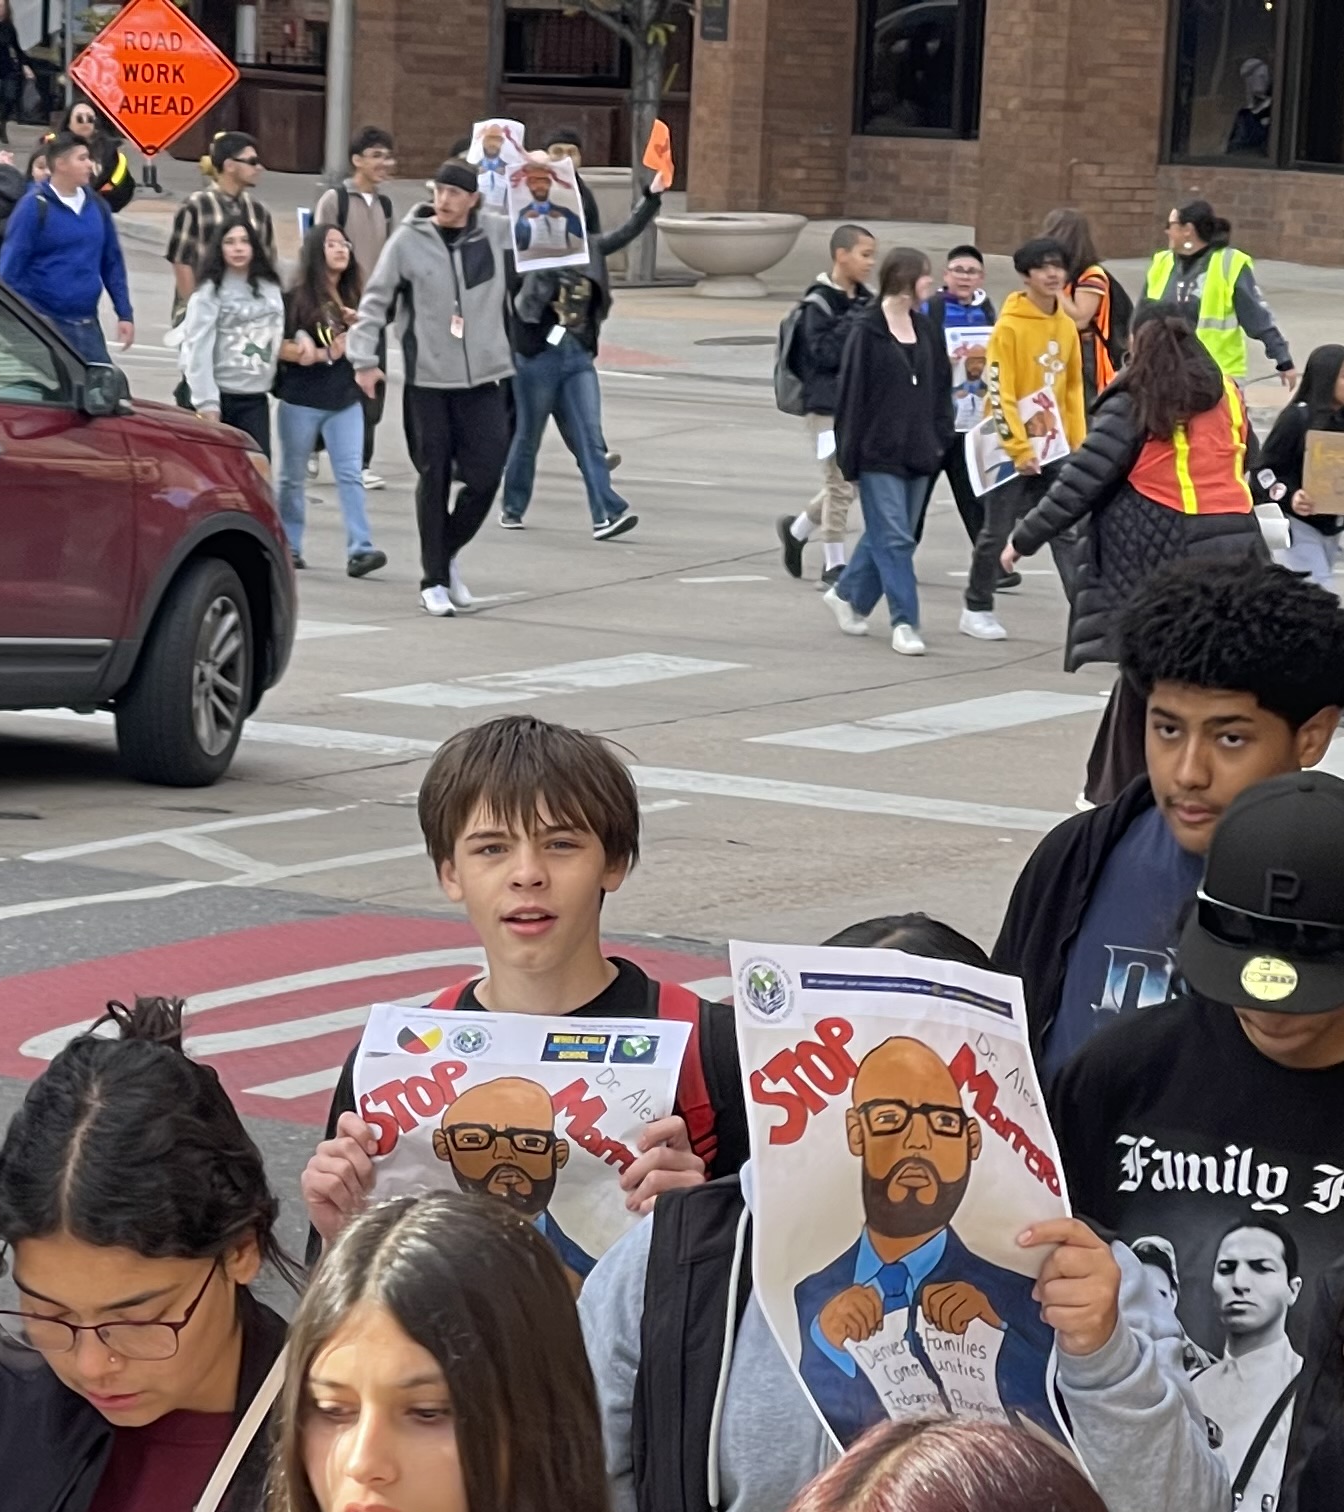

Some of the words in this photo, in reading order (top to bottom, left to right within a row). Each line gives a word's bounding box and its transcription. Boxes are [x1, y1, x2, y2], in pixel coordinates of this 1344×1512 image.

[124, 31, 183, 51] ROAD
[123, 63, 185, 83] WORK
[118, 95, 194, 116] AHEAD
[1263, 867, 1301, 916] P
[975, 1031, 997, 1067] Dr.
[596, 1067, 621, 1094] Dr.
[749, 1016, 859, 1145] STOP
[360, 1060, 468, 1156] STOP
[552, 1077, 638, 1176] Morr
[947, 1042, 1062, 1197] Morrero
[1115, 1134, 1290, 1215] Family
[856, 1338, 907, 1370] Denver
[925, 1327, 988, 1361] Families
[933, 1357, 986, 1382] unities
